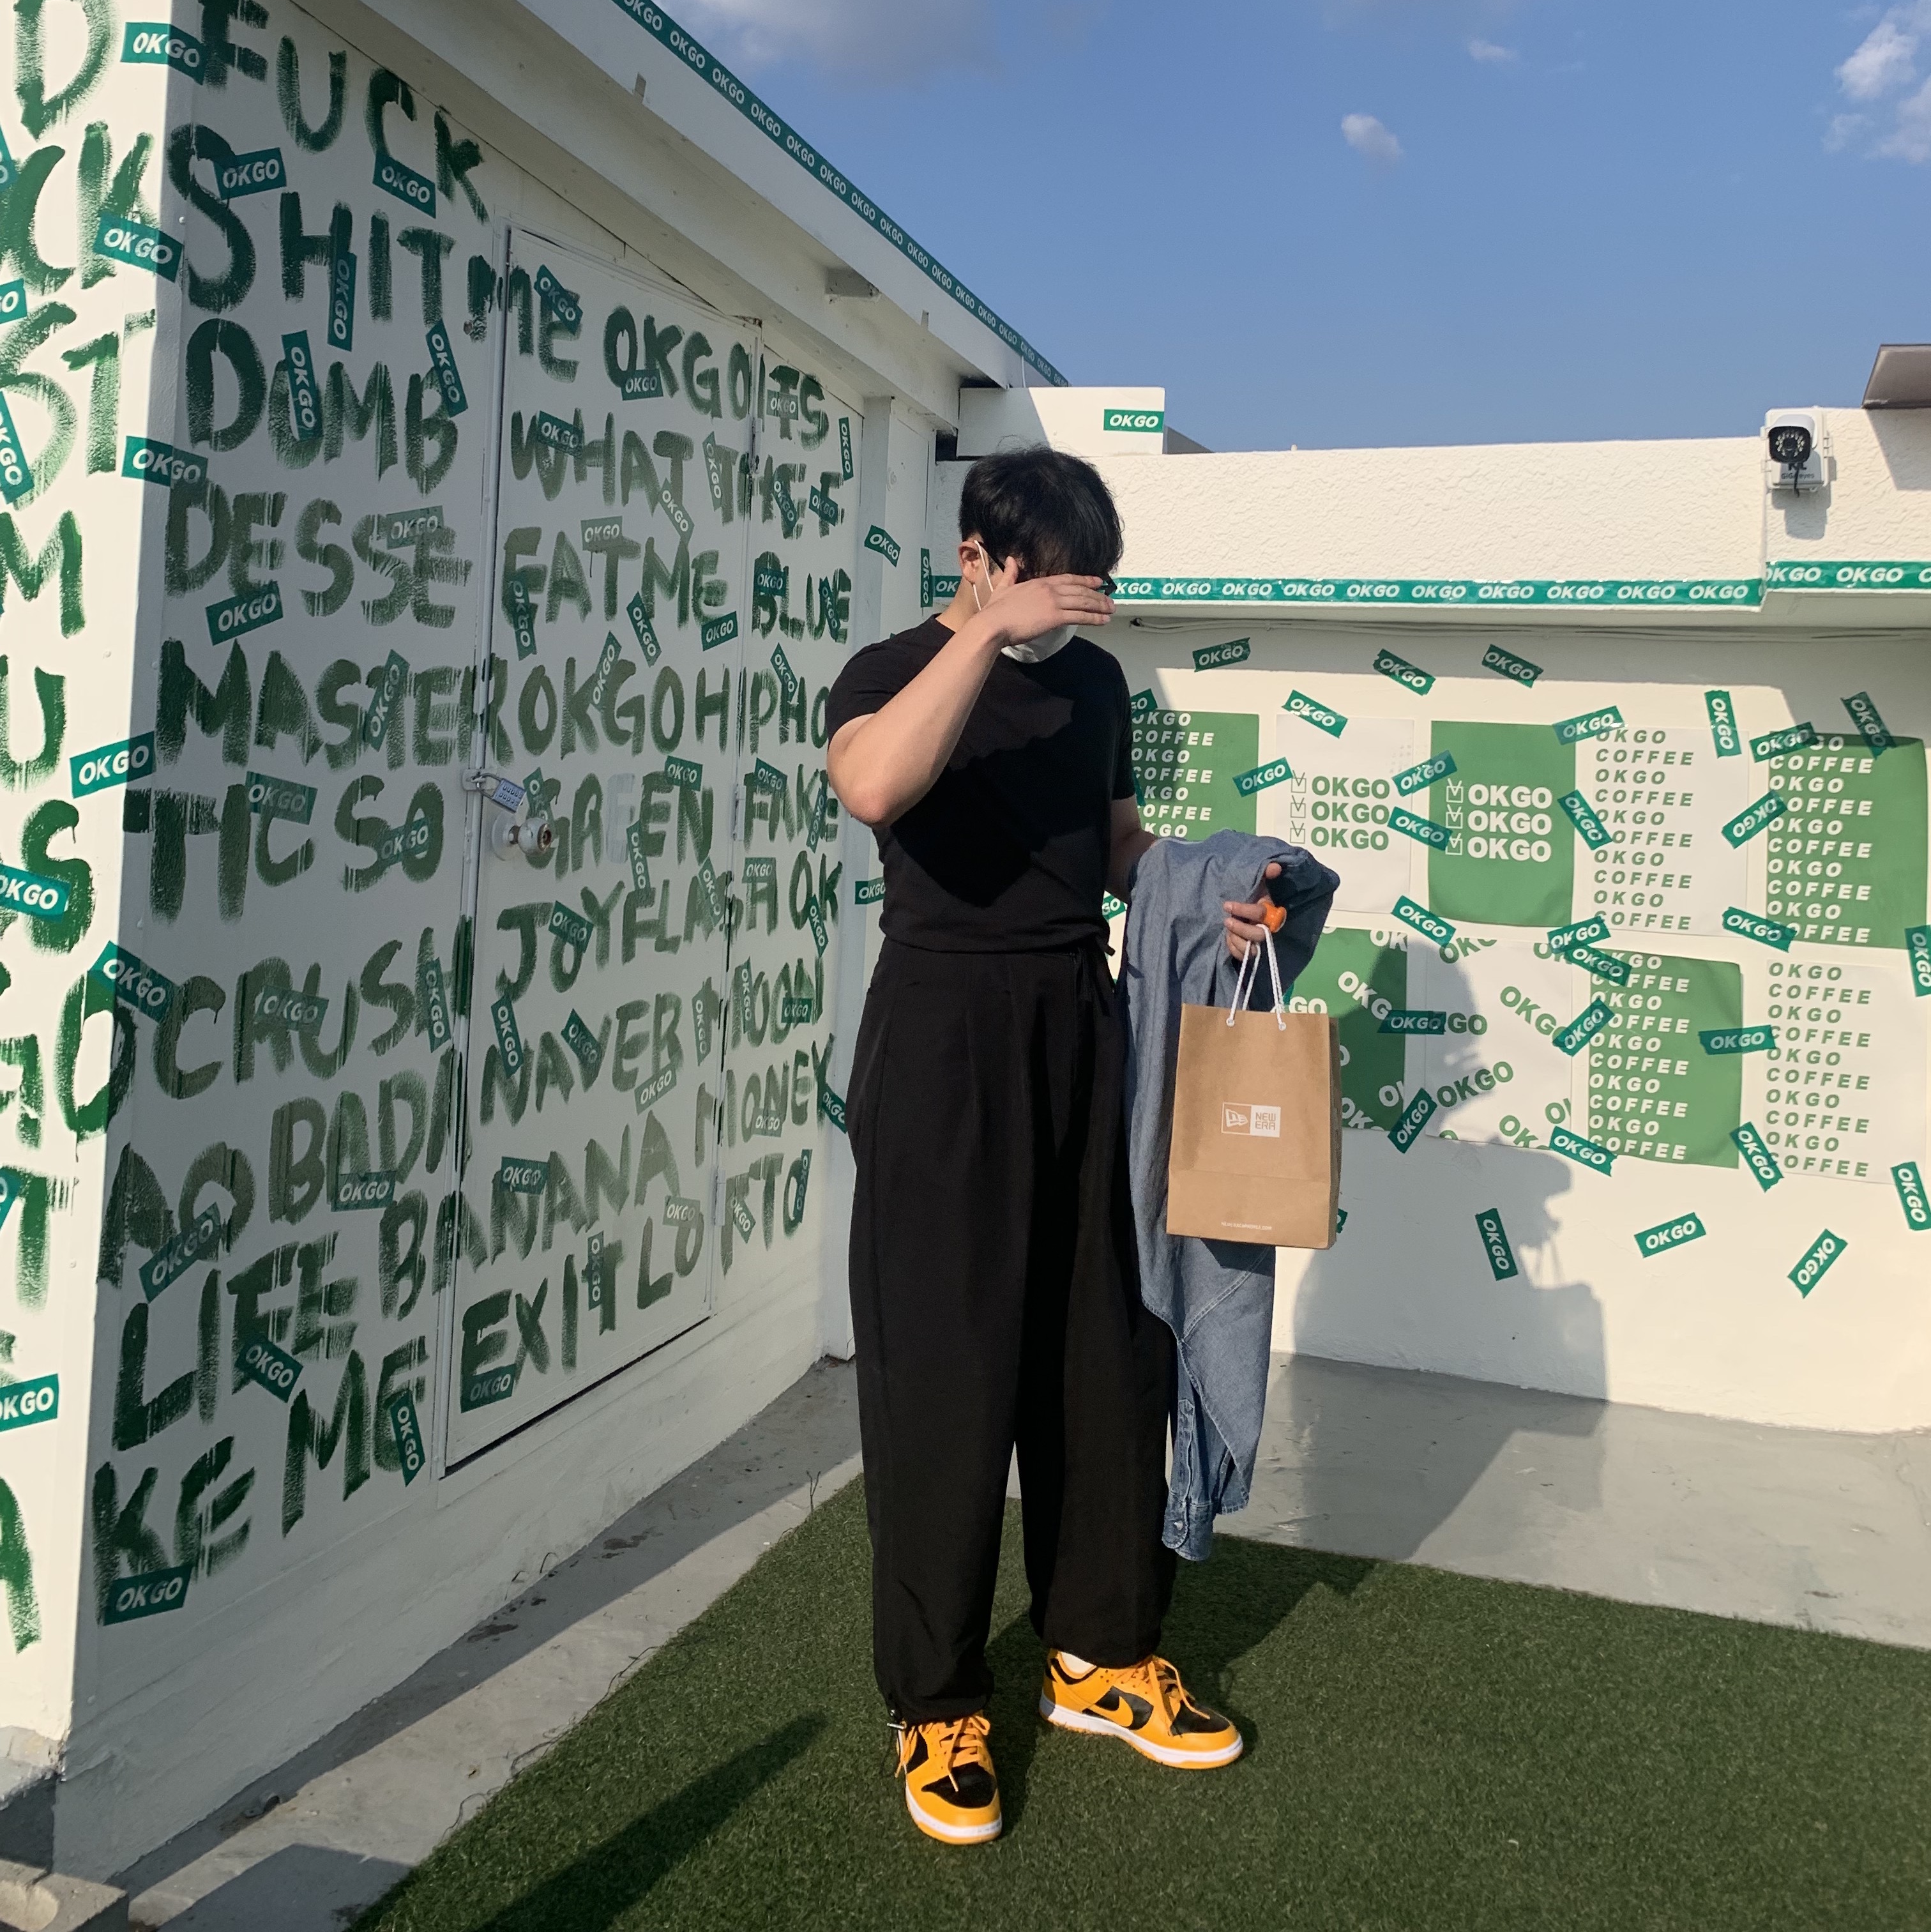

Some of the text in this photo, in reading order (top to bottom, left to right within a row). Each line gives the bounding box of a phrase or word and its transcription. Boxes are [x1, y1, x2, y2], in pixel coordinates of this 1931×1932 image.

[132, 33, 201, 67] OKGO
[199, 0, 489, 223] FUCK
[223, 159, 280, 188] OKGO
[382, 164, 431, 203] OKGO
[670, 31, 974, 310] OKGO OKGO OKGO OKGO OKGO OKGO OKGO OKGO OKGO OKGO
[103, 228, 173, 264] OKGO
[170, 123, 457, 330] SHIT
[603, 305, 752, 421] OKGO
[540, 276, 576, 321] OKGO
[432, 333, 460, 404] OKGO
[291, 346, 314, 429] OKGO
[625, 376, 658, 393] OKGO
[186, 318, 458, 496] DUMB
[511, 407, 694, 515] WHAT
[1109, 414, 1158, 428] OKGO
[541, 421, 580, 448] OKGO
[840, 423, 852, 475] OKGO
[132, 447, 201, 479] OKGO
[662, 489, 690, 533] OKGO
[390, 515, 439, 541] OKGO
[584, 522, 621, 544] OKGO
[870, 533, 899, 560] OKGO
[757, 572, 784, 591] OKGO
[1836, 567, 1904, 582] OKGO
[751, 551, 852, 645] BLUE
[1162, 582, 1748, 600] OKGO OKGO OKGO OKGO OKGO OKGO OKGO OKGO OKGO
[218, 593, 276, 631] OKGO
[632, 606, 657, 657] OKGO
[706, 619, 734, 643] OKGO
[1198, 645, 1243, 666] OKGO
[1484, 651, 1533, 680] OKGO
[593, 644, 616, 704] OKGO
[1379, 658, 1425, 688] OKGO
[371, 664, 400, 737] OKGO
[1291, 698, 1335, 727] OKGO
[1563, 714, 1614, 736] OKGO
[1712, 697, 1734, 750] OKGO
[1851, 699, 1885, 747] OKGO
[1133, 730, 1213, 746] COFFEE
[1757, 729, 1810, 756] OKGO
[79, 745, 150, 785] OKGO
[1131, 749, 1190, 763] OKGO
[1596, 749, 1693, 765] COFFEE
[1769, 755, 1874, 773] COFFEE
[1241, 764, 1285, 791] OKGO
[1312, 776, 1390, 799] OKGO
[1400, 761, 1446, 789] OKGO
[1596, 769, 1665, 784] OKGO
[1769, 775, 1844, 793] OKGO
[249, 783, 308, 812] OKGO
[1468, 784, 1552, 809] OKGO
[1595, 789, 1693, 807] COFFEE
[1312, 802, 1390, 825] OKGO
[1468, 810, 1552, 835] OKGO
[1564, 797, 1603, 842] OKGO
[1768, 817, 1843, 835] OKGO
[382, 825, 429, 858] OKGO
[1311, 826, 1389, 850] OKGO
[1395, 816, 1444, 842] OKGO
[1467, 837, 1552, 862] OKGO
[1594, 850, 1664, 866] OKGO
[1768, 838, 1872, 858] COFFEE
[1594, 870, 1692, 889] COFFEE
[1768, 858, 1842, 877] OKGO
[1594, 890, 1663, 907] OKGO
[1768, 880, 1872, 901] COFFEE
[1399, 906, 1446, 938] OKGO
[1767, 901, 1841, 920] OKGO
[496, 880, 626, 1003] JOY
[789, 850, 844, 930] OK
[552, 911, 587, 941] OKGO
[810, 905, 826, 947] OKGO
[1550, 924, 1601, 950] OKGO
[1727, 915, 1782, 941] OKGO
[1572, 948, 1624, 977] OKGO
[1769, 962, 1842, 980] OKGO
[103, 960, 166, 1006] OKGO
[1769, 984, 1872, 1005] COFFEE
[262, 996, 319, 1021] OKGO
[425, 970, 444, 1038] OKGO
[1768, 1005, 1842, 1024] OKGO
[1390, 1016, 1445, 1029] OKGO
[1563, 1009, 1604, 1049] OKGO
[1590, 1032, 1662, 1052] OKGO
[1710, 1032, 1766, 1050] OKGO
[480, 992, 685, 1126] NAVER
[1589, 1053, 1689, 1076] COFFEE
[639, 1070, 672, 1103] OKGO
[1437, 1061, 1513, 1107] OKGO
[1589, 1074, 1660, 1093] OKGO
[1767, 1069, 1870, 1090] COFFEE
[1589, 1094, 1688, 1118] COFFEE
[1766, 1089, 1840, 1108] OKGO
[1255, 1112, 1276, 1122] NEW
[1255, 1121, 1276, 1130] ERA
[1397, 1099, 1429, 1145] OKGO
[1589, 1114, 1660, 1136] OKGO
[1766, 1111, 1870, 1134] COFFEE
[1554, 1136, 1607, 1165] OKGO
[1738, 1130, 1775, 1180] OKGO
[1766, 1131, 1839, 1152] OKGO
[339, 1182, 390, 1202] OKGO
[1898, 1168, 1927, 1222] OKGO
[1483, 1218, 1509, 1270] OKGO
[1645, 1221, 1697, 1249] OKGO
[151, 1219, 215, 1285] OKGO
[245, 1346, 294, 1388] OKGO
[282, 1334, 430, 1539] ME
[460, 1240, 623, 1396] EXIT
[397, 1406, 420, 1471] OKGO
[116, 1577, 184, 1612] OKGO
